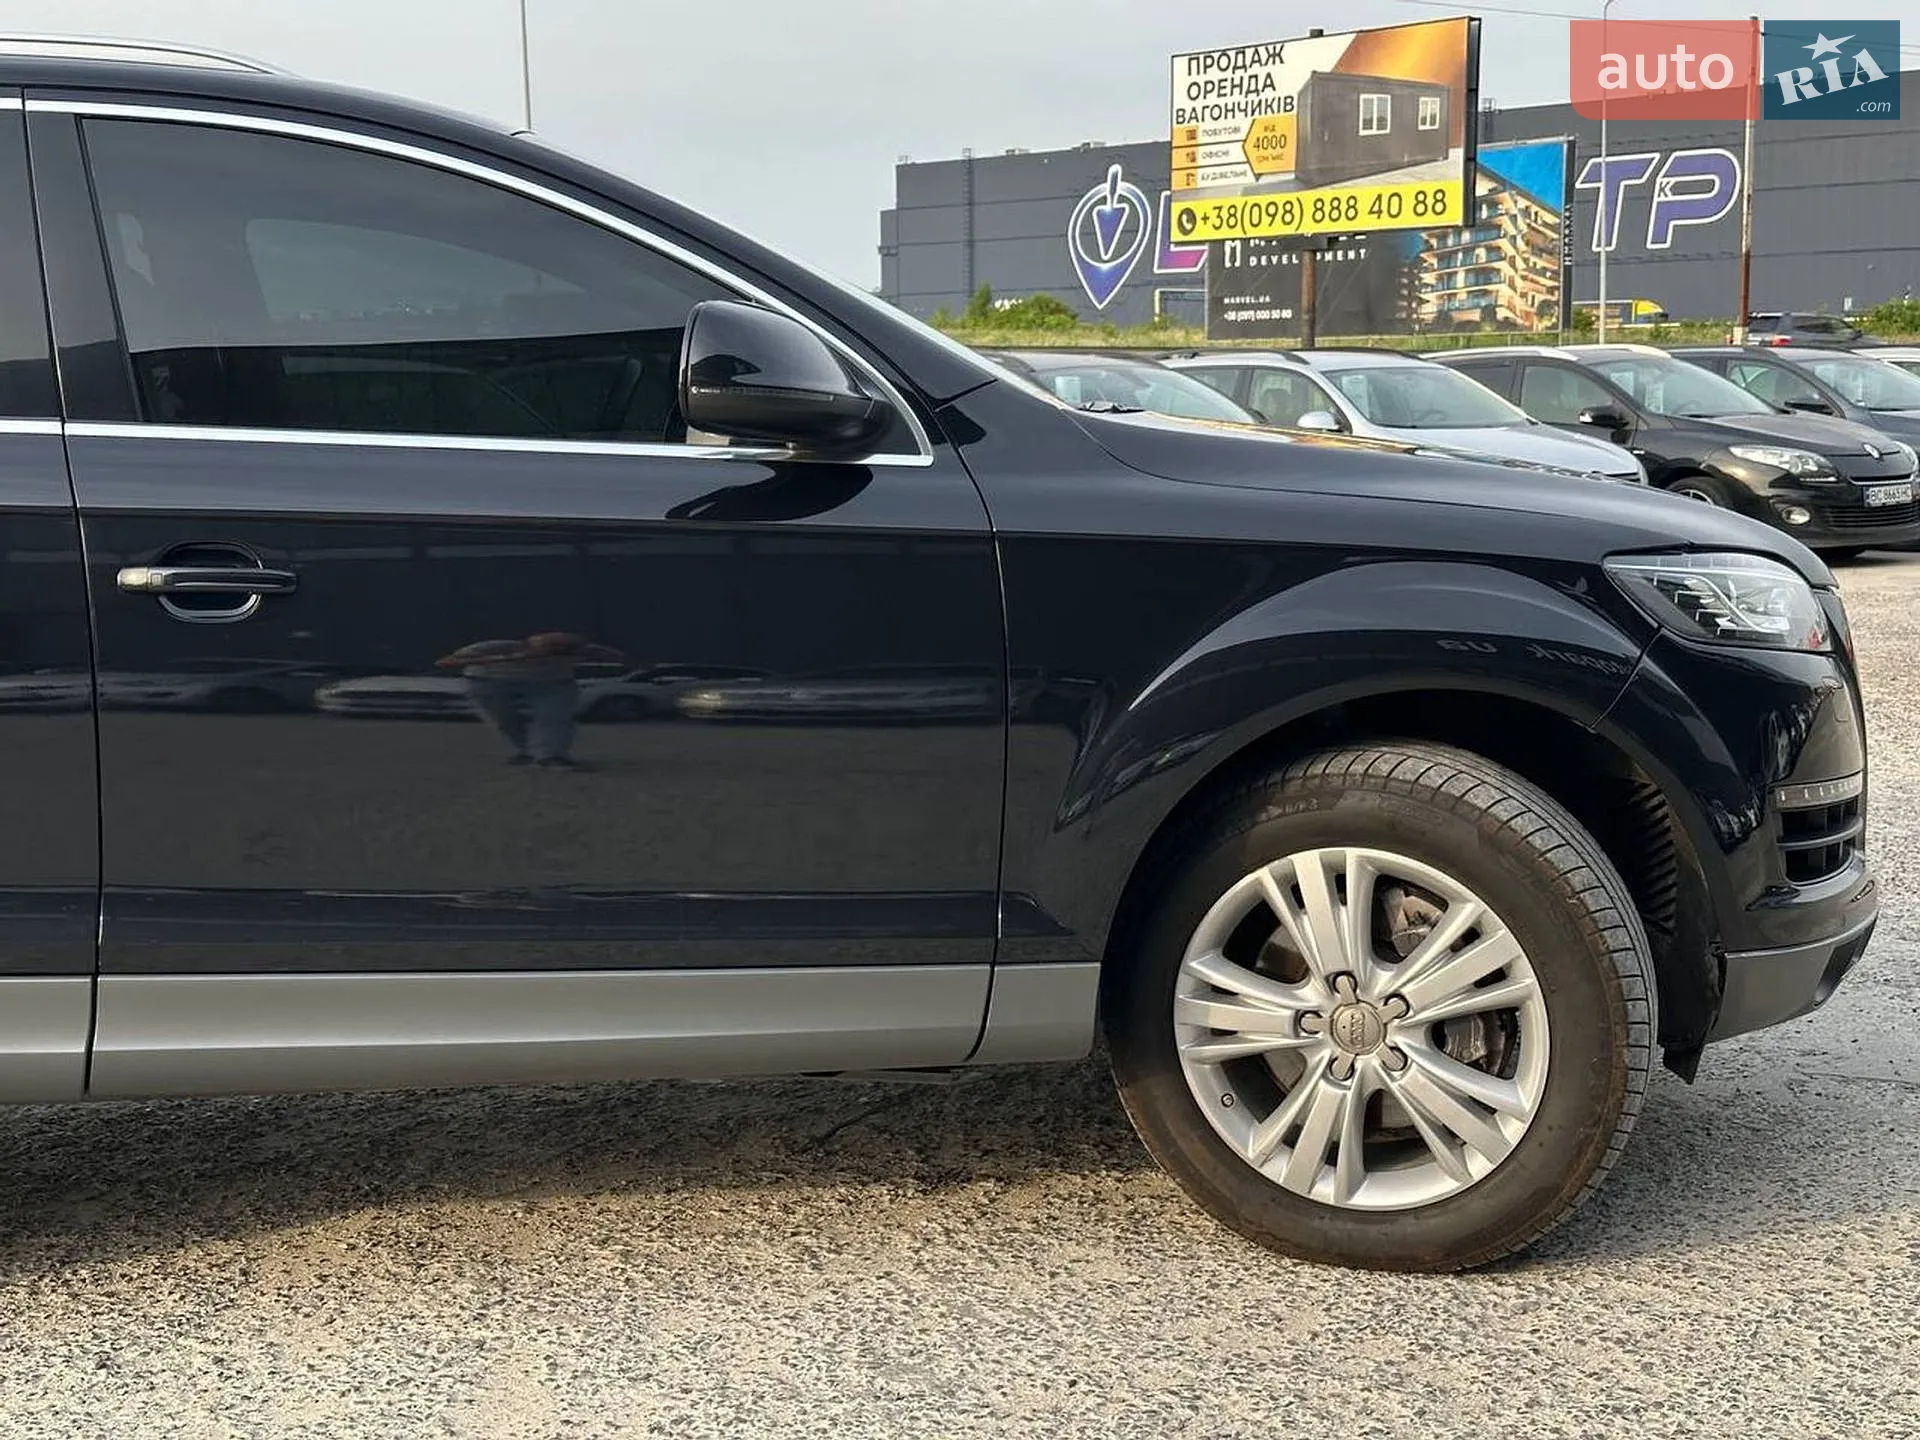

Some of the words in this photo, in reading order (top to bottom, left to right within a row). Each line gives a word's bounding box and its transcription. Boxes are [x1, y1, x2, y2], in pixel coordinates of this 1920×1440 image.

[1187, 44, 1285, 77] ПРОДАЖ
[1187, 71, 1276, 102] ОРЕНДА
[1175, 95, 1295, 126] ВАГОНЧИКІВ
[1253, 134, 1287, 152] 4000
[1200, 197, 1304, 235] +38(098)
[1312, 195, 1358, 224] 888
[1368, 192, 1403, 221] 40
[1413, 189, 1447, 218] 88
[1250, 248, 1367, 267] DEVELMENT
